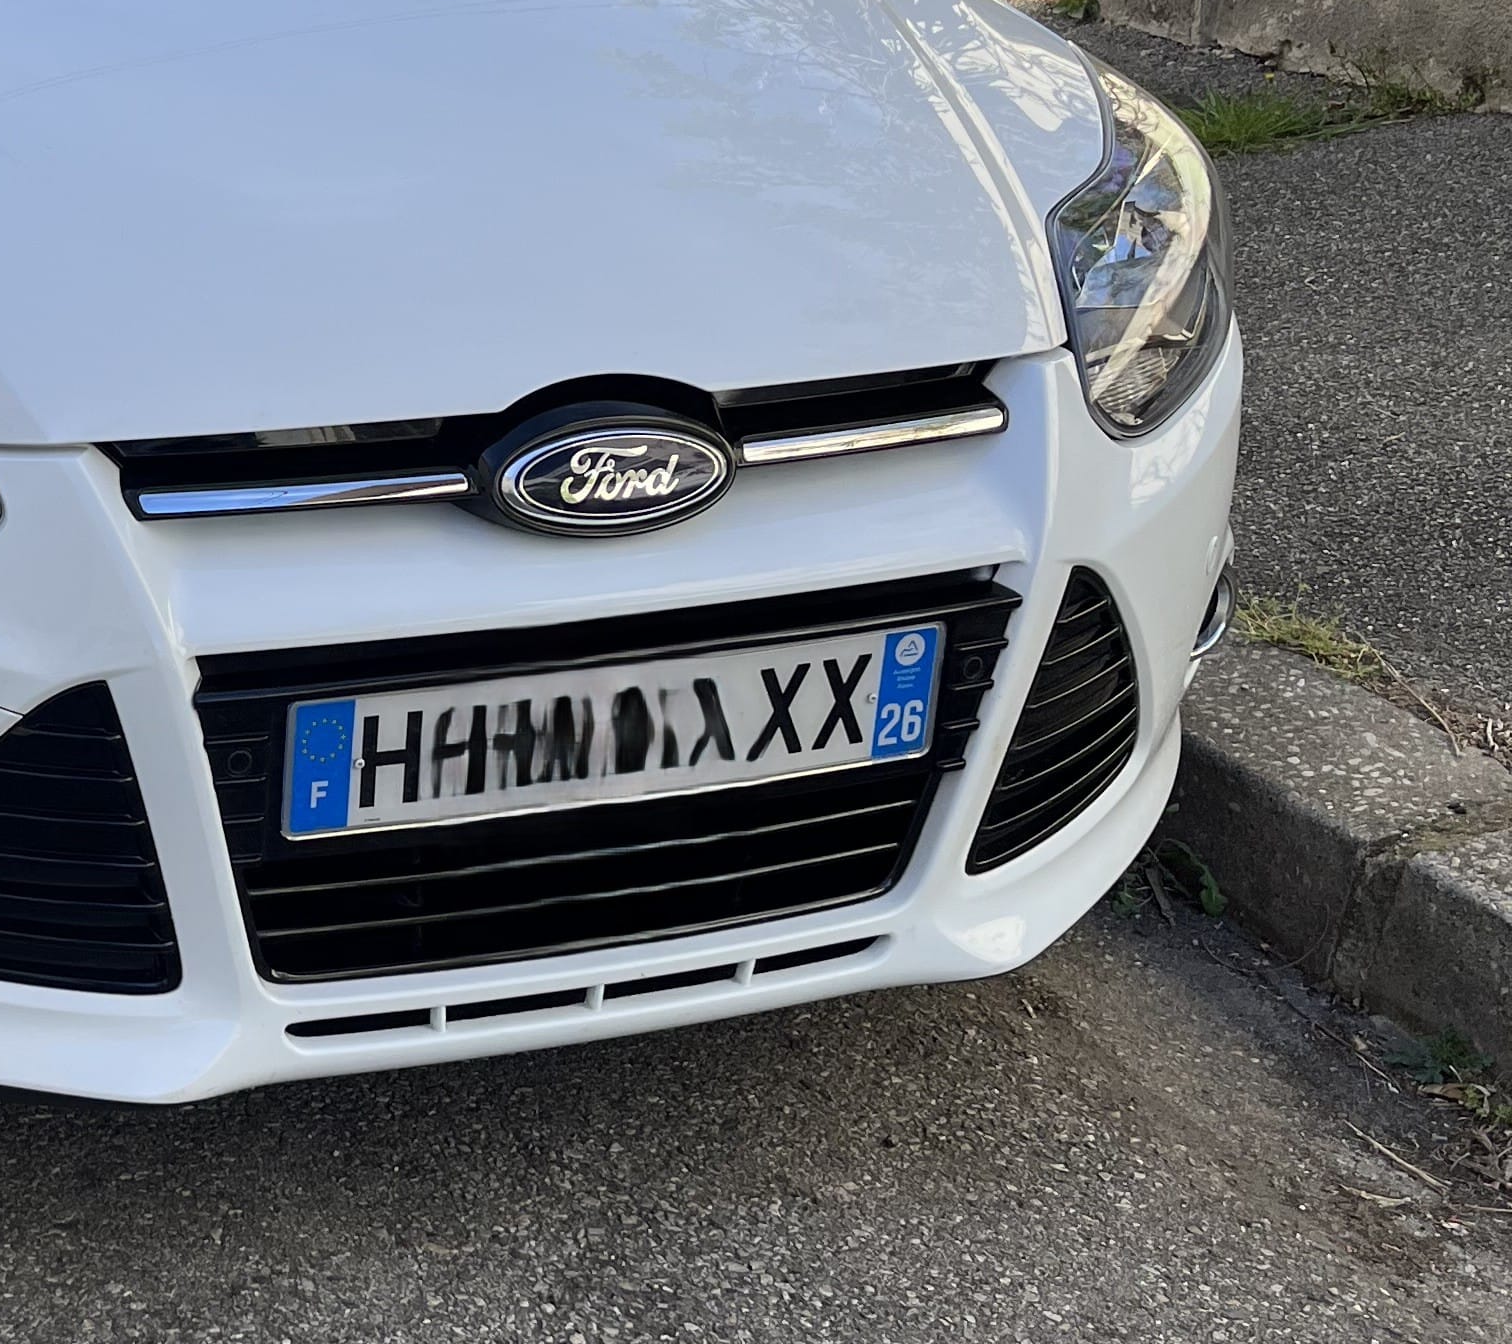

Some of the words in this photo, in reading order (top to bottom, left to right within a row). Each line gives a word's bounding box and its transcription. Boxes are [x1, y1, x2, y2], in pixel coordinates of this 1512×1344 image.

[560, 444, 680, 505] Ford
[877, 699, 924, 747] 26
[310, 780, 329, 809] F
